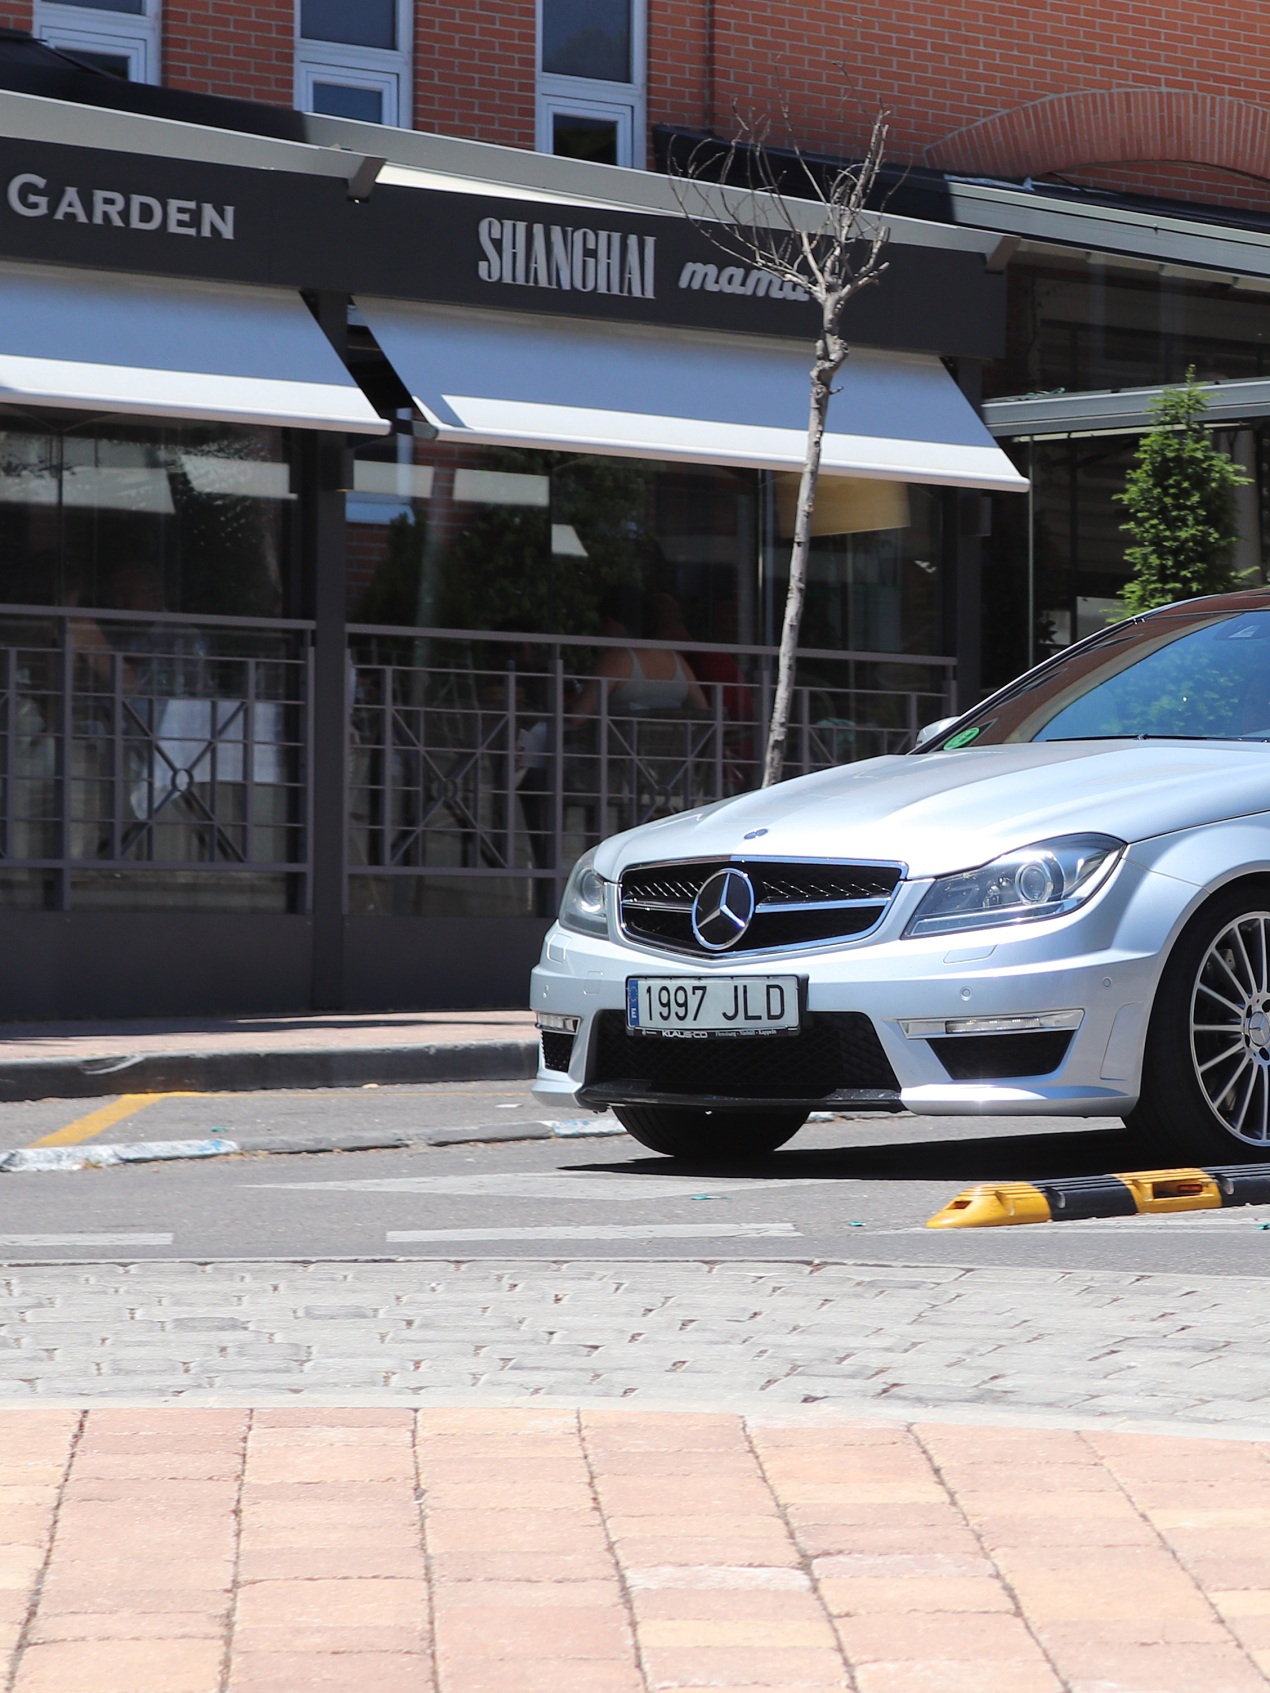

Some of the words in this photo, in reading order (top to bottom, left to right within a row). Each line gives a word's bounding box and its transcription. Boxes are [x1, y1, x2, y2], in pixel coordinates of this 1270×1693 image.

[7, 172, 236, 240] GARDEN
[477, 216, 657, 300] SHANGHAI
[677, 261, 810, 302] mama
[631, 1007, 637, 1018] E
[646, 985, 707, 1021] 1997
[721, 984, 786, 1022] JLD
